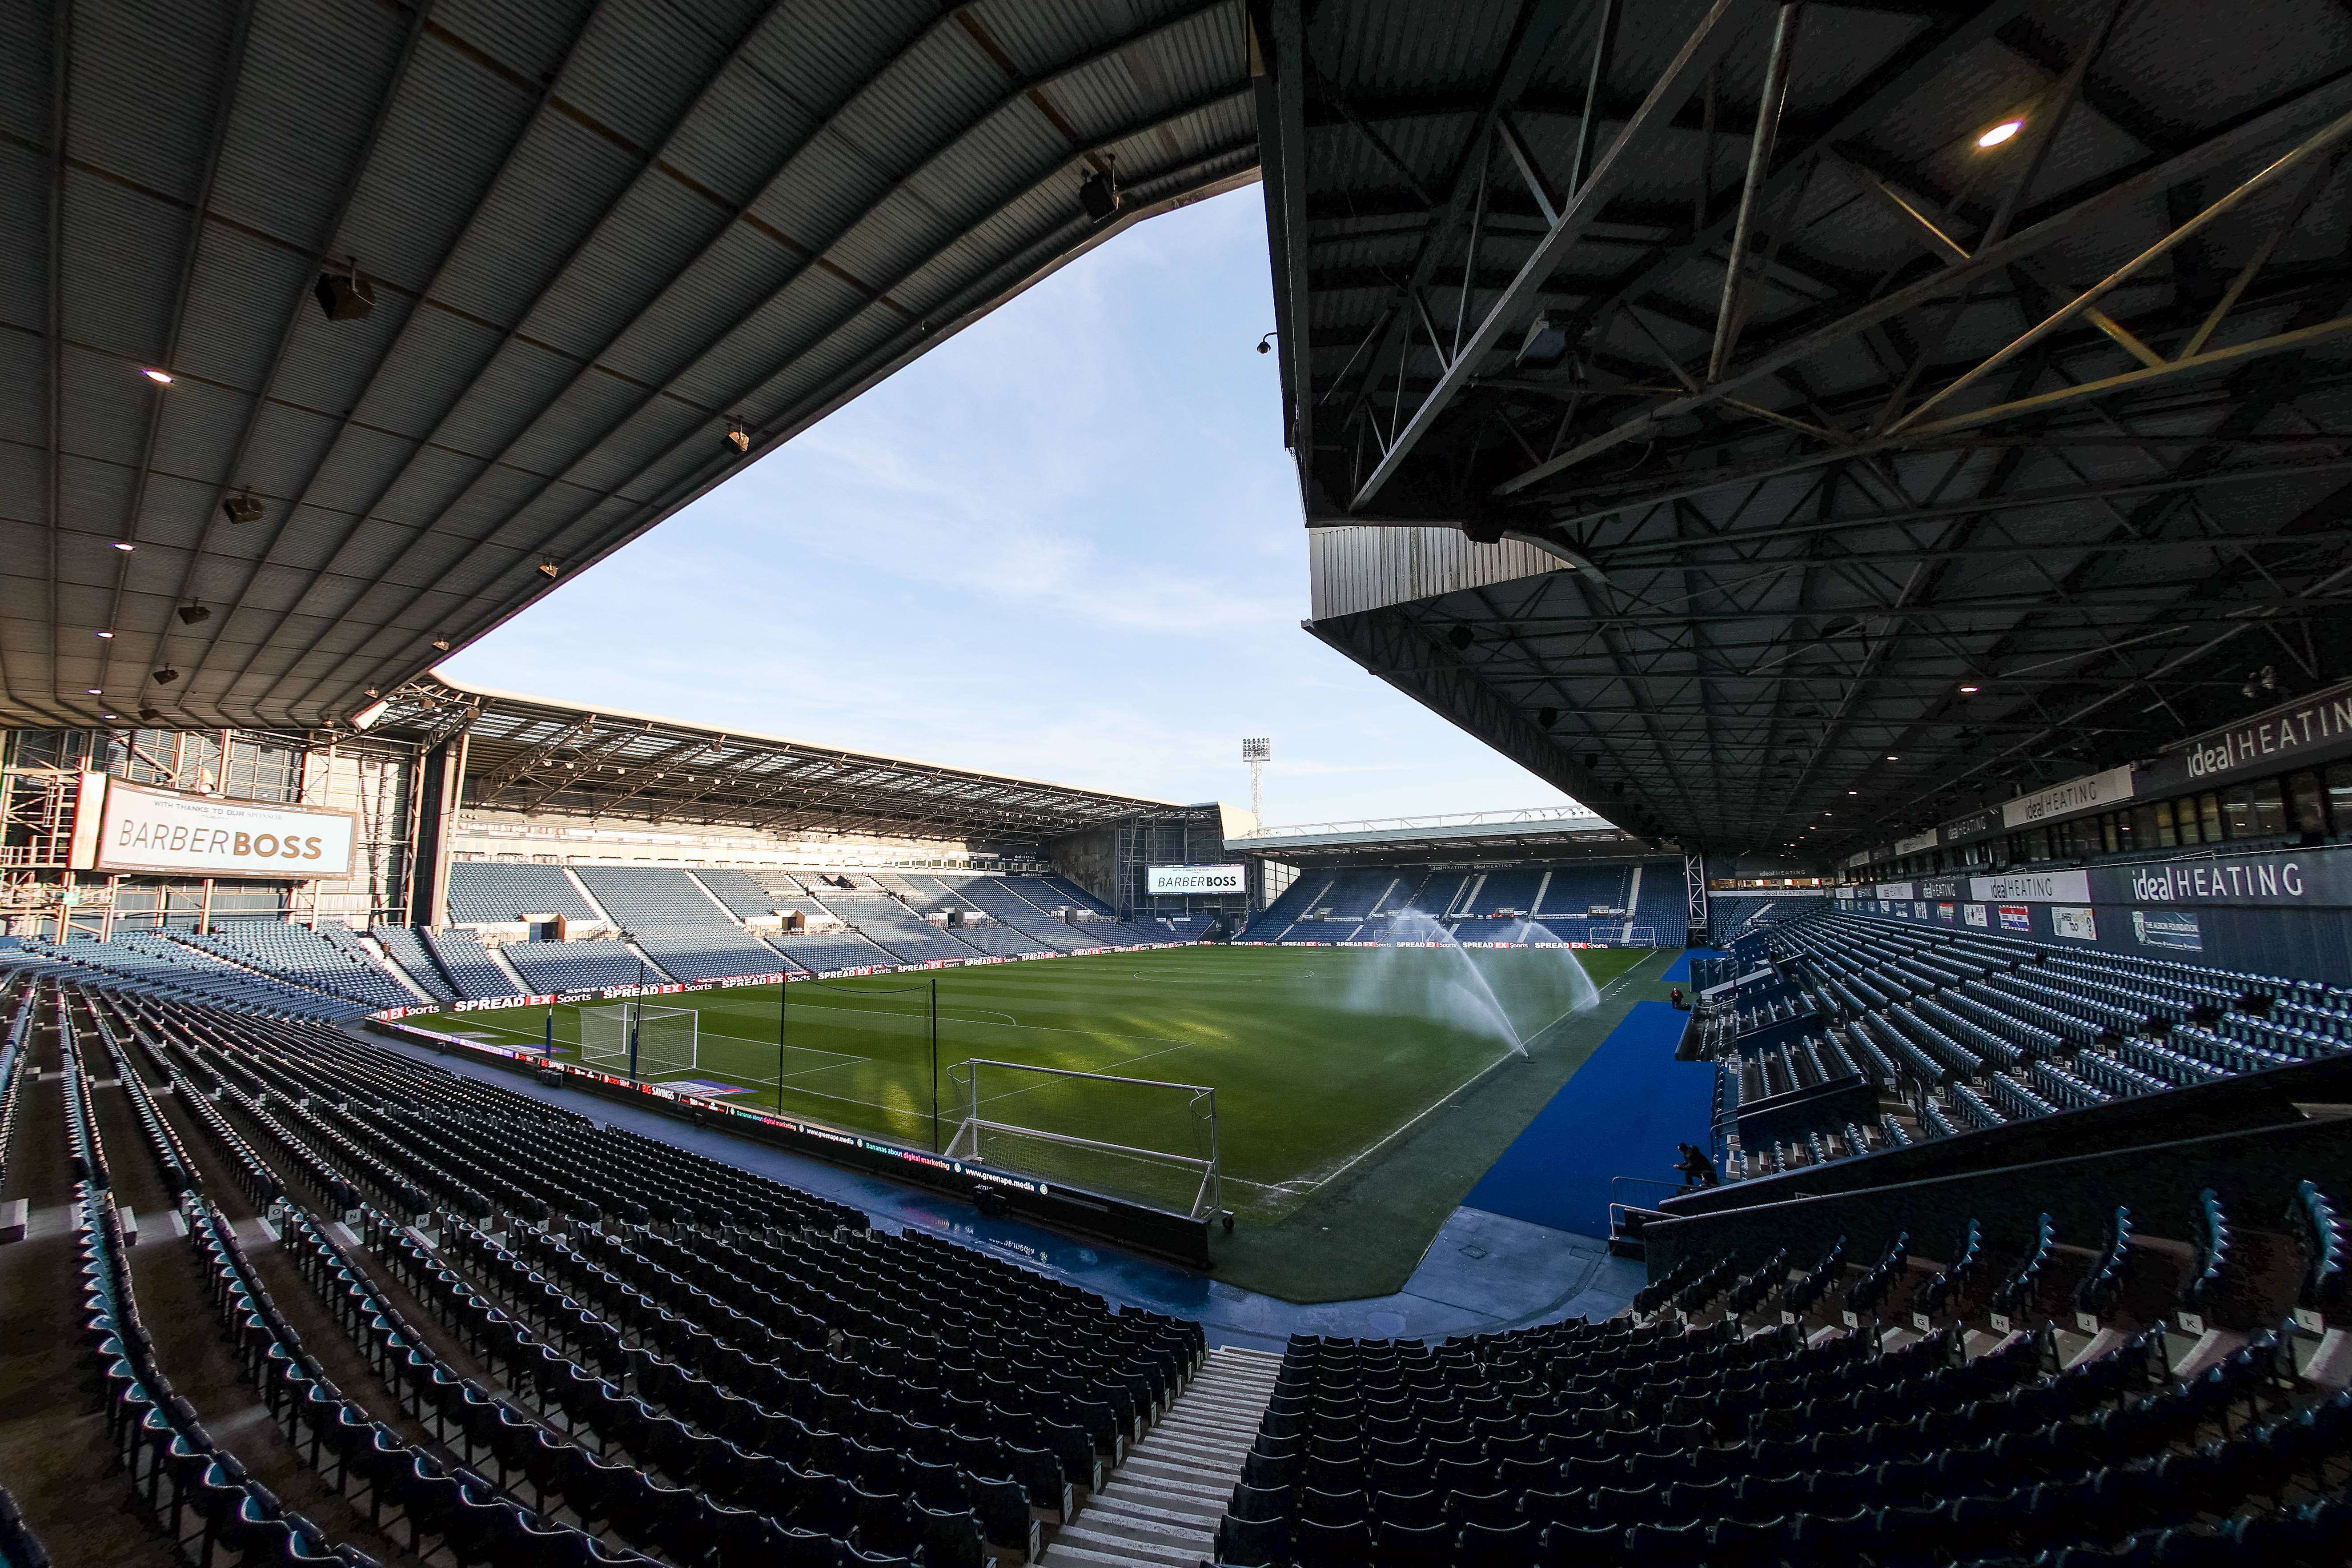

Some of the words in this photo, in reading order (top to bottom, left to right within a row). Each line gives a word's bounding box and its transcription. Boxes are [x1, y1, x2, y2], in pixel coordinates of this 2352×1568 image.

[2187, 734, 2235, 778] ideal
[2238, 698, 2352, 759] HEATIN
[2025, 795, 2046, 819] ideal
[2046, 781, 2097, 812] HEATING
[177, 803, 209, 813] THANKS
[119, 819, 322, 859] BARBERBOSS
[1158, 876, 1236, 887] BARBERBOSS
[1991, 878, 2007, 898] ideal
[2007, 878, 2052, 896] HEATING
[2132, 867, 2175, 900] ideal
[2176, 863, 2303, 897] HEATING
[1932, 883, 1955, 897] HEATING
[1231, 931, 1242, 941] SPREAD
[897, 964, 929, 973] SPREAD
[965, 958, 991, 966] SPREAD
[722, 978, 767, 988] SPREAD
[770, 975, 783, 983] EX
[818, 970, 855, 980] SPREAD
[602, 984, 659, 999] SPREAD
[663, 983, 682, 993] EX
[684, 983, 712, 992] Sports
[454, 997, 525, 1012] SPREAD
[530, 994, 552, 1005] EX
[556, 993, 591, 1003] Sports
[406, 1004, 440, 1016] Sports
[652, 1087, 675, 1101] SAVINGS
[737, 1111, 752, 1119] Bananas
[807, 1128, 854, 1145] www.greenape.media
[866, 1142, 887, 1153] Bananas
[887, 1147, 903, 1158] about
[903, 1152, 920, 1163] digital
[921, 1157, 950, 1171] marketing
[965, 1167, 1035, 1191] www.greenape.media
[2085, 1319, 2090, 1327] J
[2186, 1319, 2197, 1329] K
[2304, 1316, 2313, 1325] L
